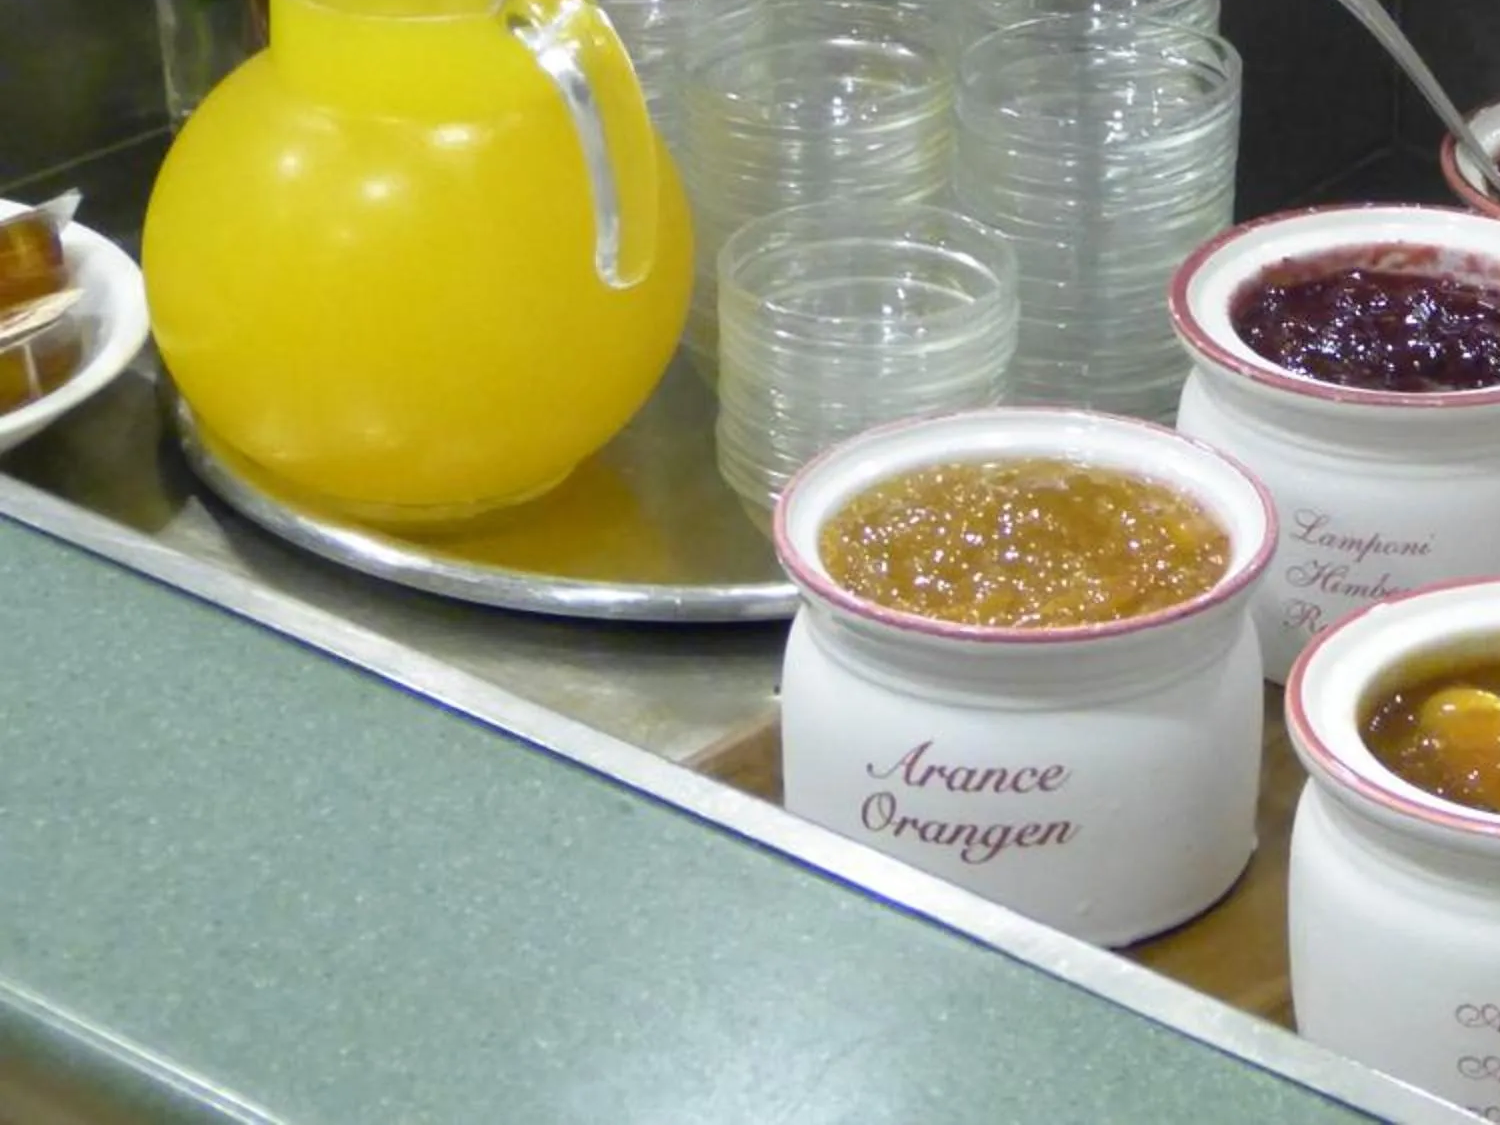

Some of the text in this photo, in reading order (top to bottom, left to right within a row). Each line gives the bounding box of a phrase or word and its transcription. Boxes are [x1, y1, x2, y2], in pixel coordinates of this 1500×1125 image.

[1289, 508, 1436, 563] Lamponi
[866, 740, 1072, 793] Arance
[861, 791, 1083, 865] Orangen
